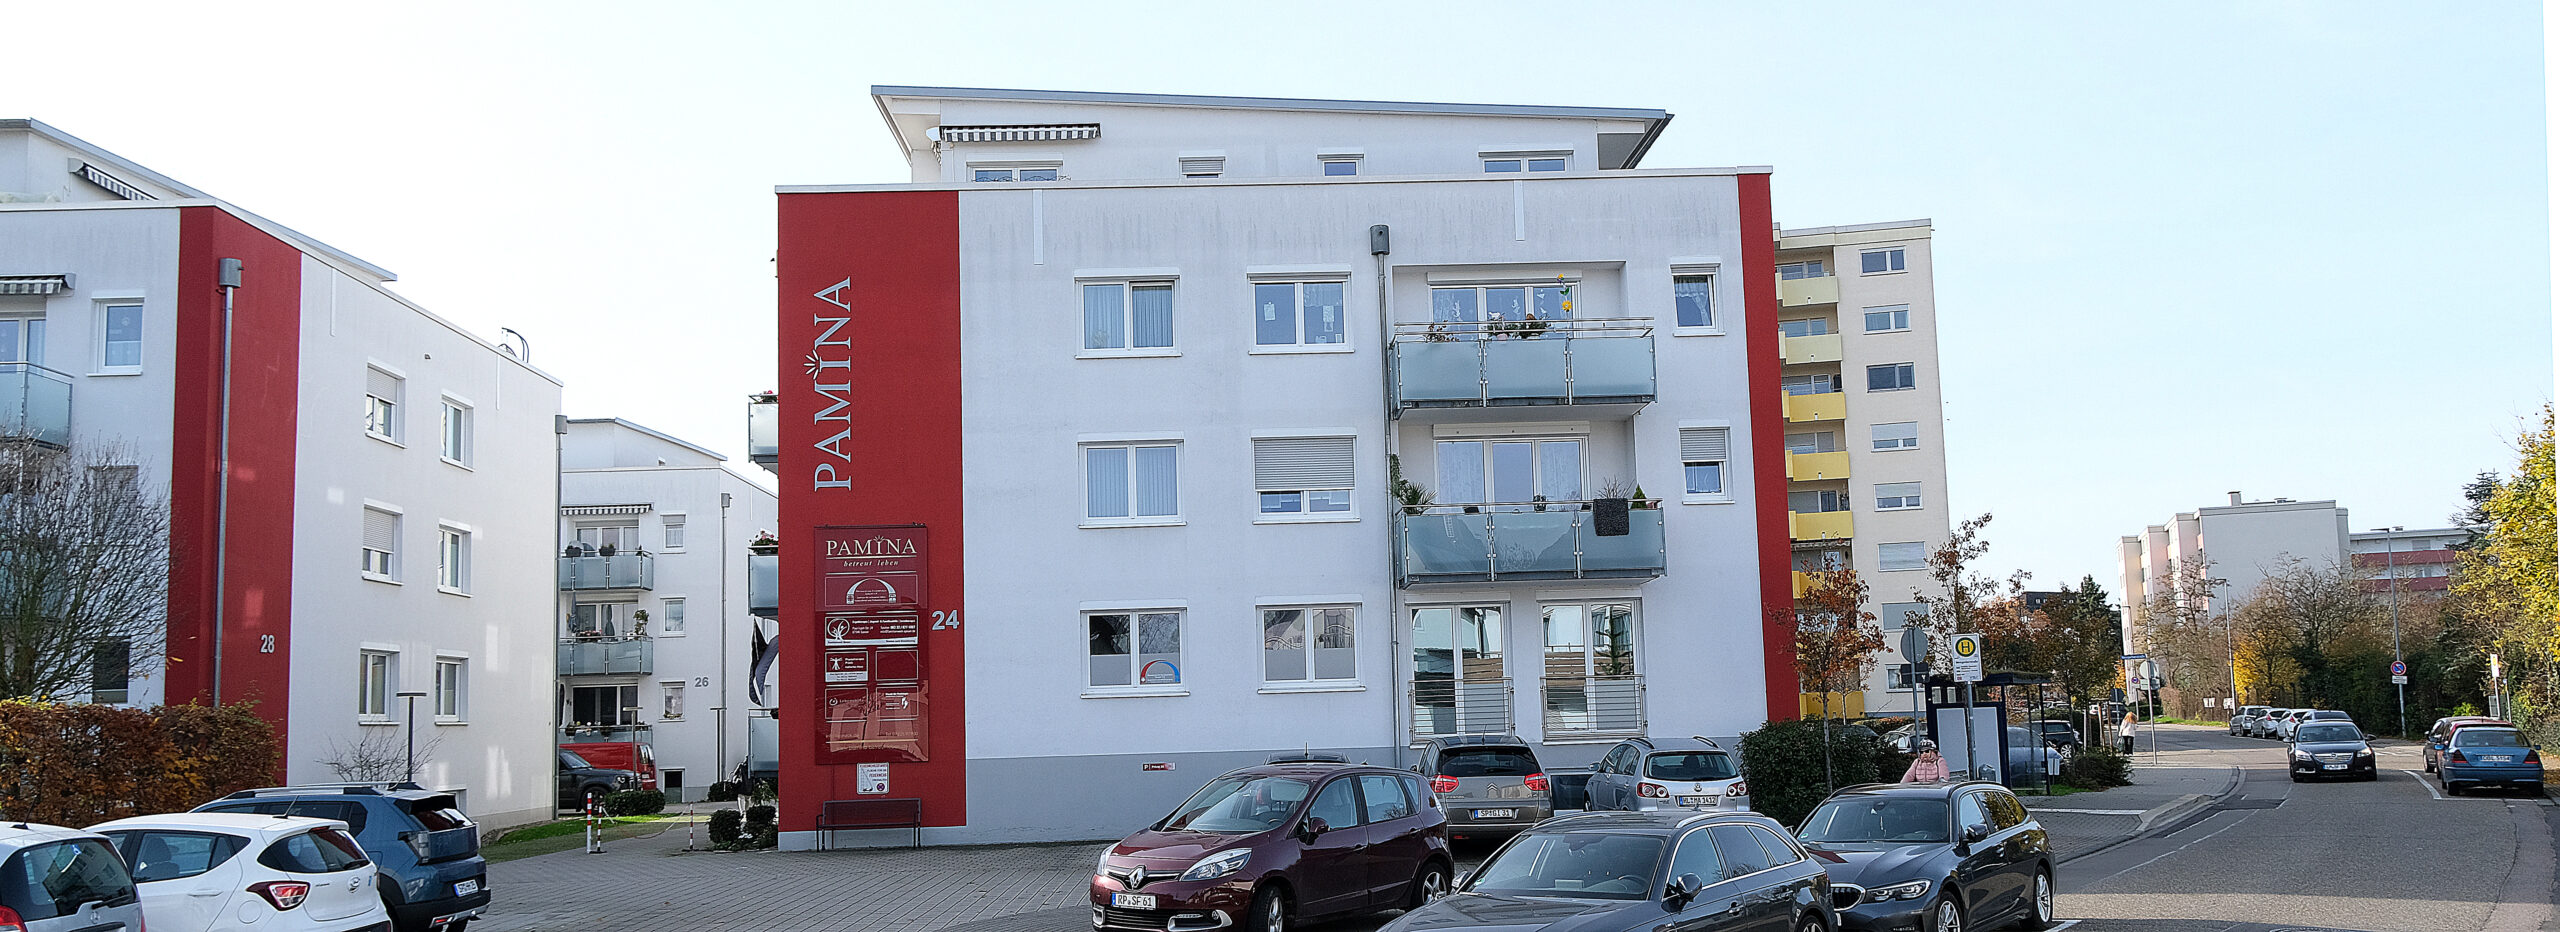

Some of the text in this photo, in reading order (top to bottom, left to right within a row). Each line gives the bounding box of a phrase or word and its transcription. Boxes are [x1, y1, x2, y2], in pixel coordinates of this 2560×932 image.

[805, 276, 852, 492] PAMINA
[826, 536, 917, 556] PAMINA
[877, 558, 899, 566] leben
[931, 609, 960, 631] 24
[260, 634, 275, 653] 28
[1961, 641, 1971, 653] H
[694, 676, 709, 688] 26
[1117, 895, 1153, 907] RP SF 61
